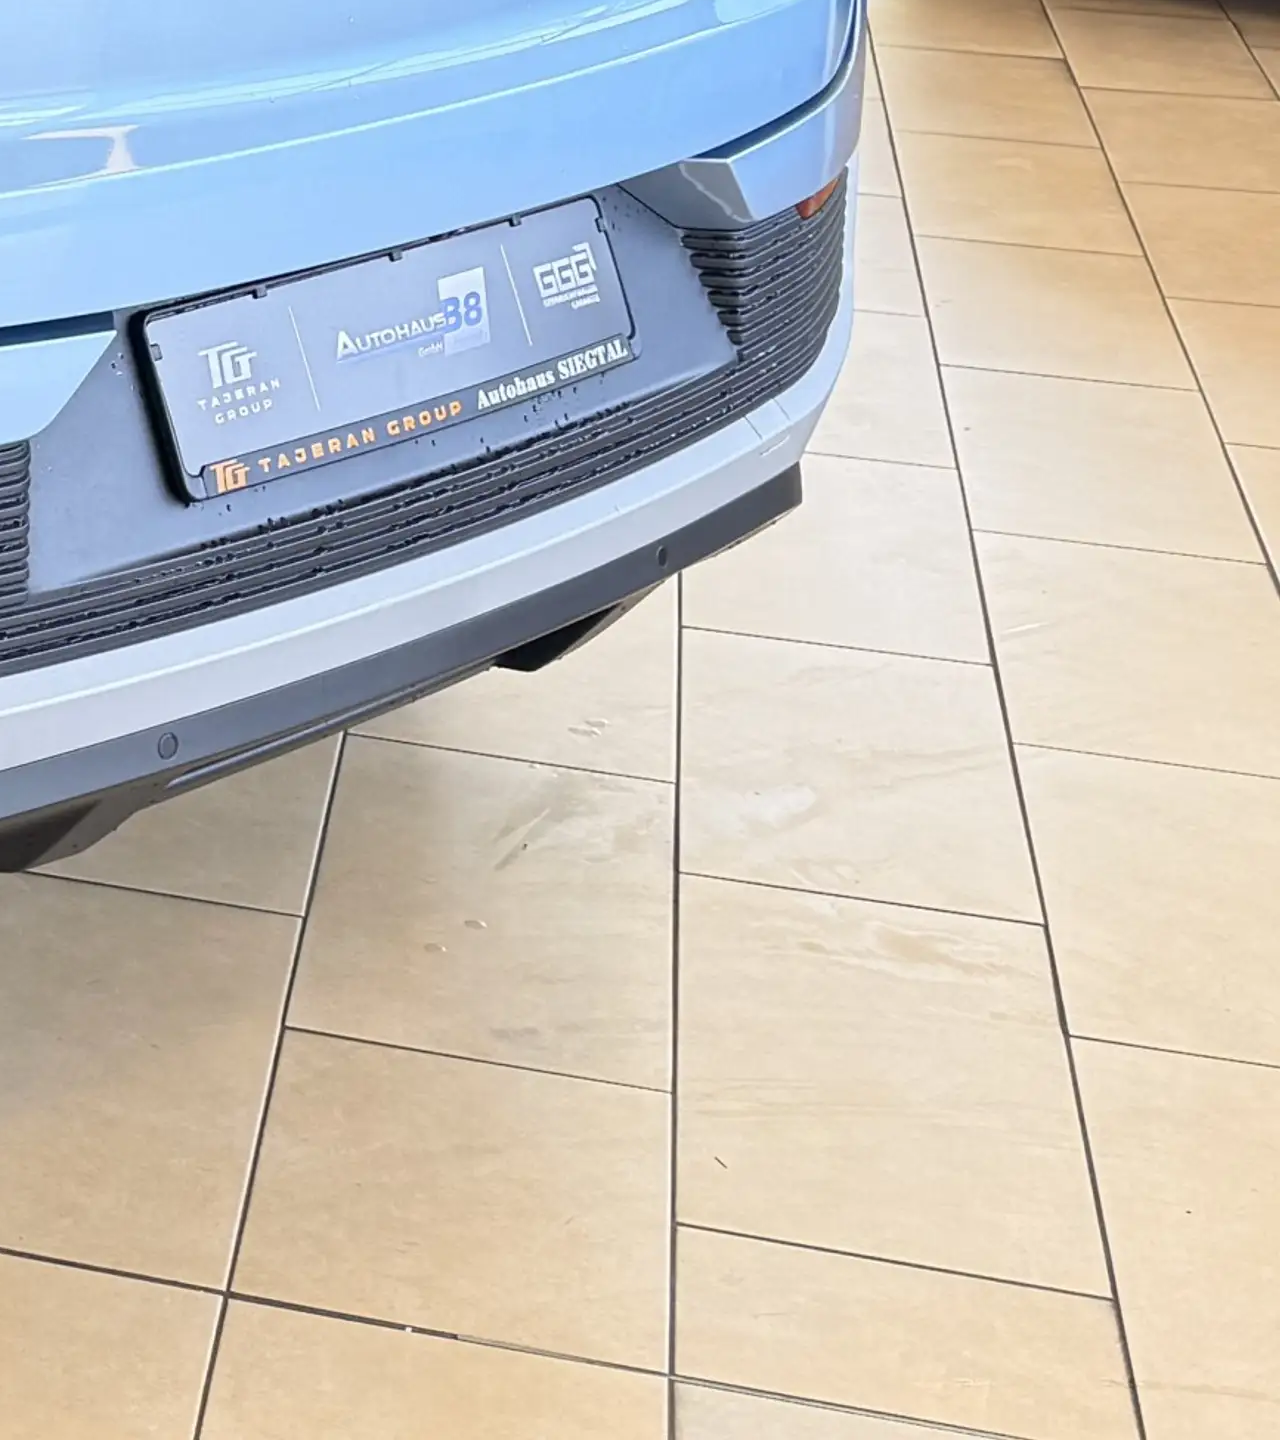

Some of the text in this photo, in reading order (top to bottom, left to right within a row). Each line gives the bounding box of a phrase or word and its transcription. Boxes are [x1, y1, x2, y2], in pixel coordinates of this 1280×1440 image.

[196, 377, 281, 411] TAJERAN
[214, 398, 273, 424] GROUP
[257, 426, 377, 473] TAJERAN
[385, 399, 465, 438] GROUP
[476, 369, 556, 411] Autohaus
[555, 338, 630, 381] SIEGTAL
